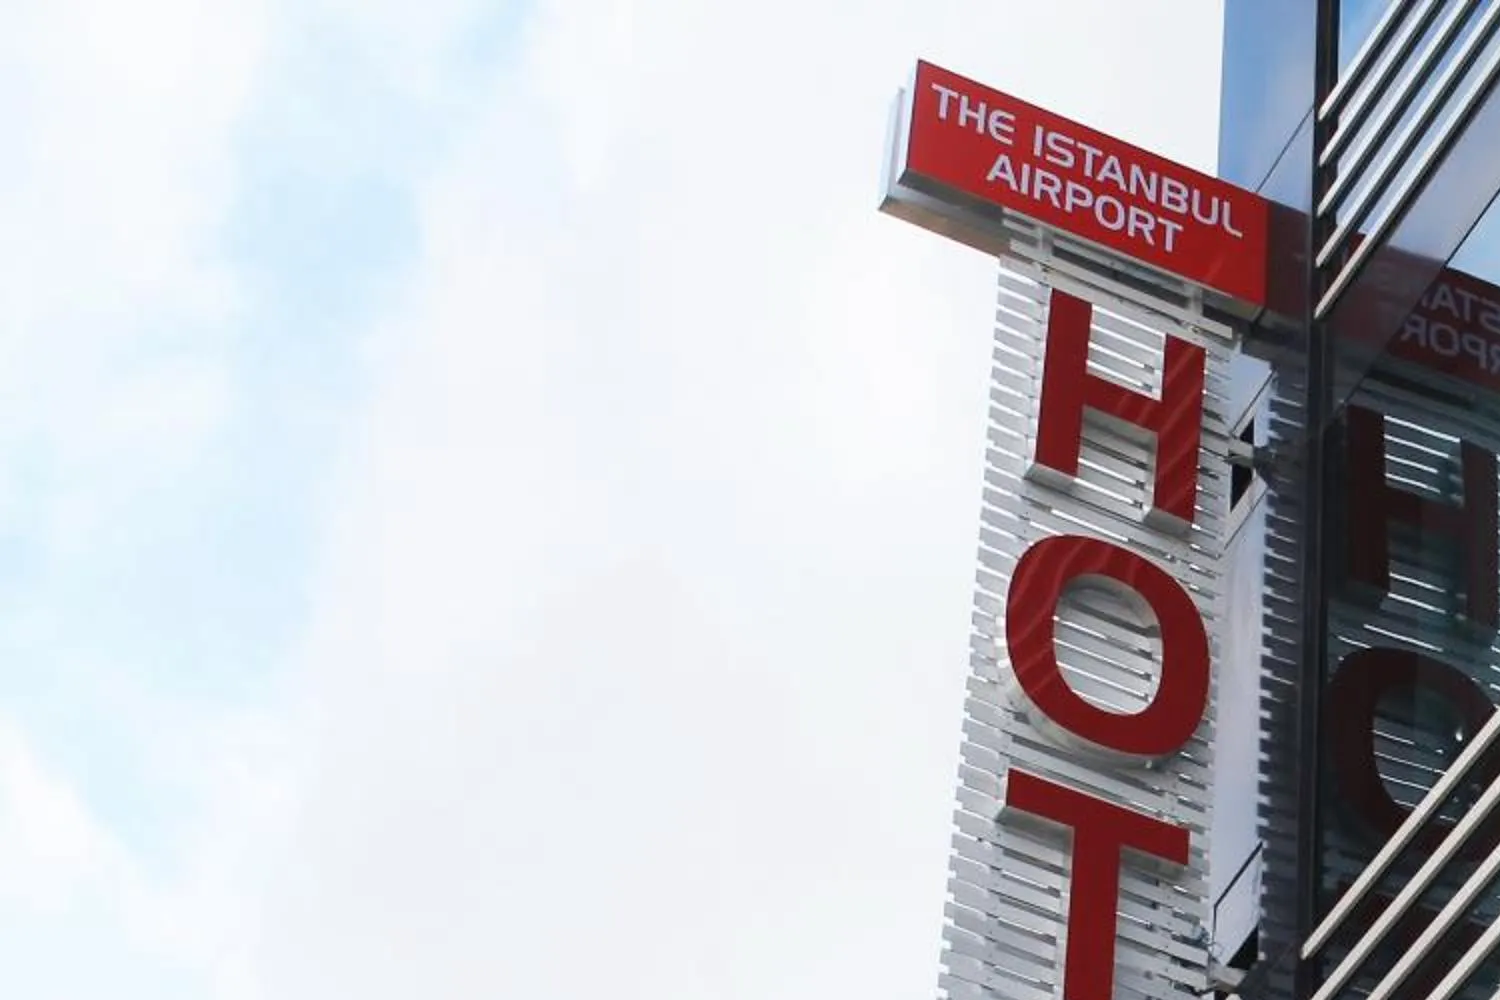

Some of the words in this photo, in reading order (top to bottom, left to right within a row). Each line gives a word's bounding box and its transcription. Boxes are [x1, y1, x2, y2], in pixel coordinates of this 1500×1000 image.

[931, 82, 1016, 146] THE
[1033, 125, 1243, 239] ISTANBUL
[986, 154, 1183, 253] AIRPORT
